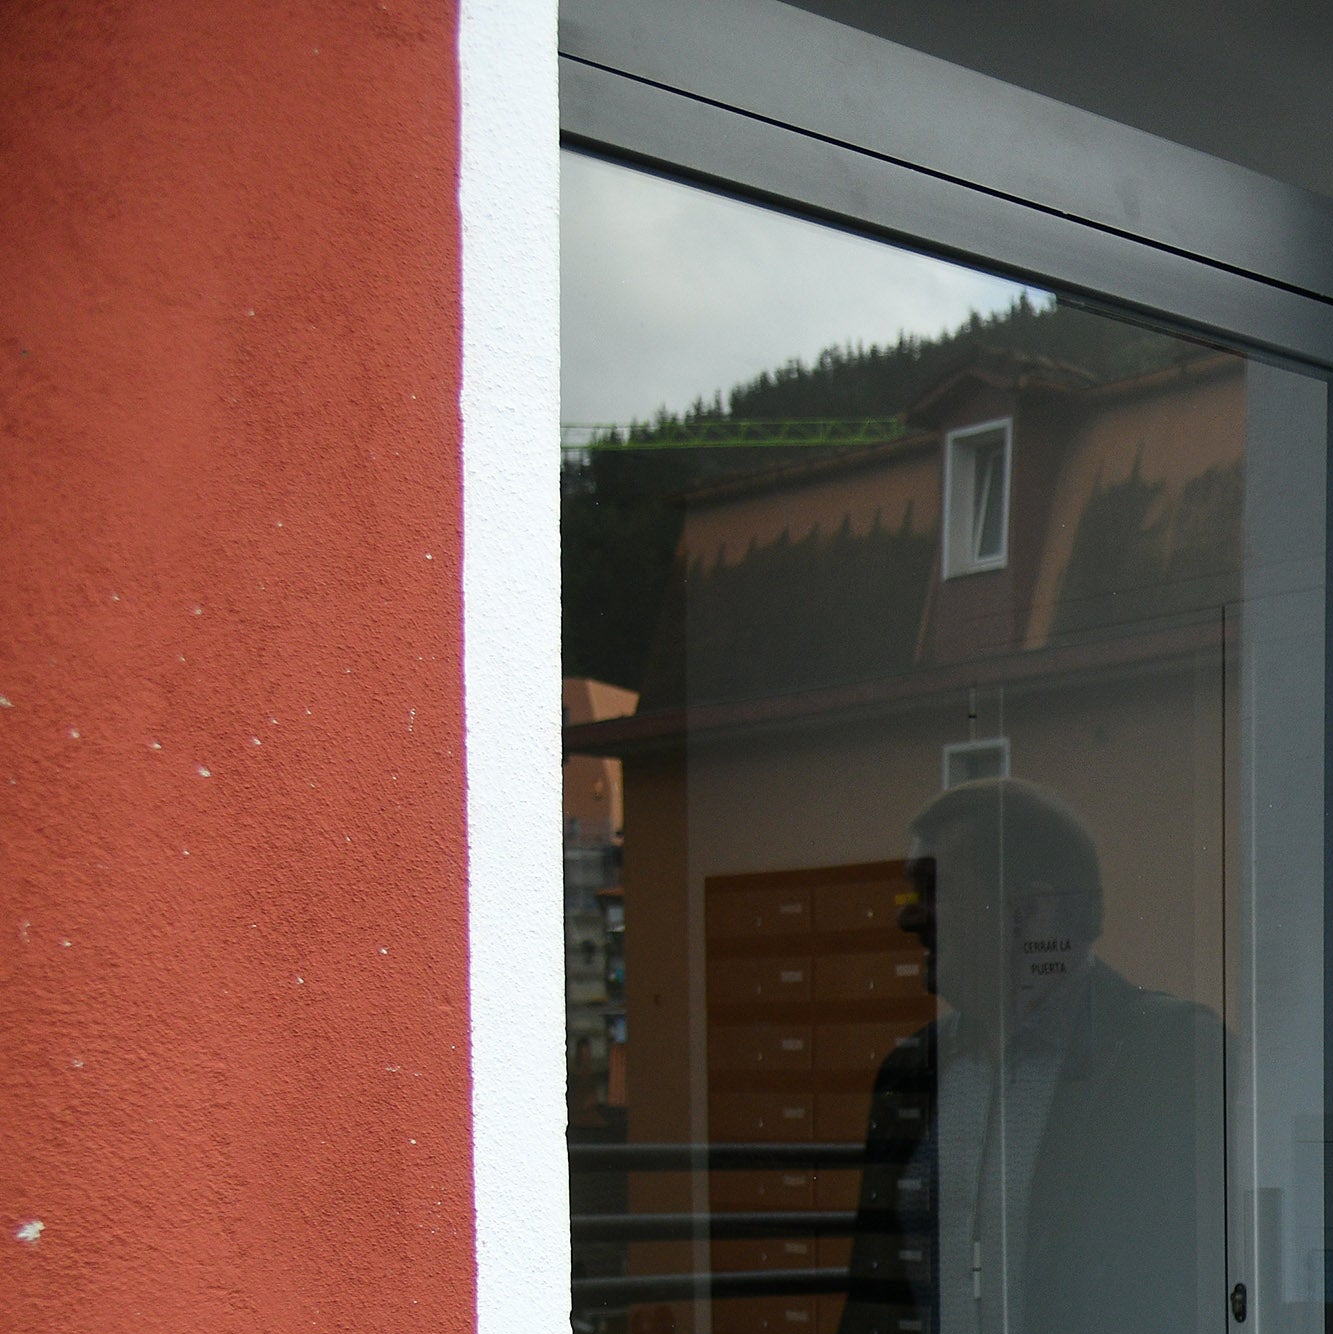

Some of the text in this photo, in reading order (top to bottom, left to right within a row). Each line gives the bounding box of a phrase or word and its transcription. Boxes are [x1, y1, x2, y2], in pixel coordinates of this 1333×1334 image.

[1024, 938, 1071, 954] CERRAR LA
[1031, 962, 1067, 975] PUERTA
